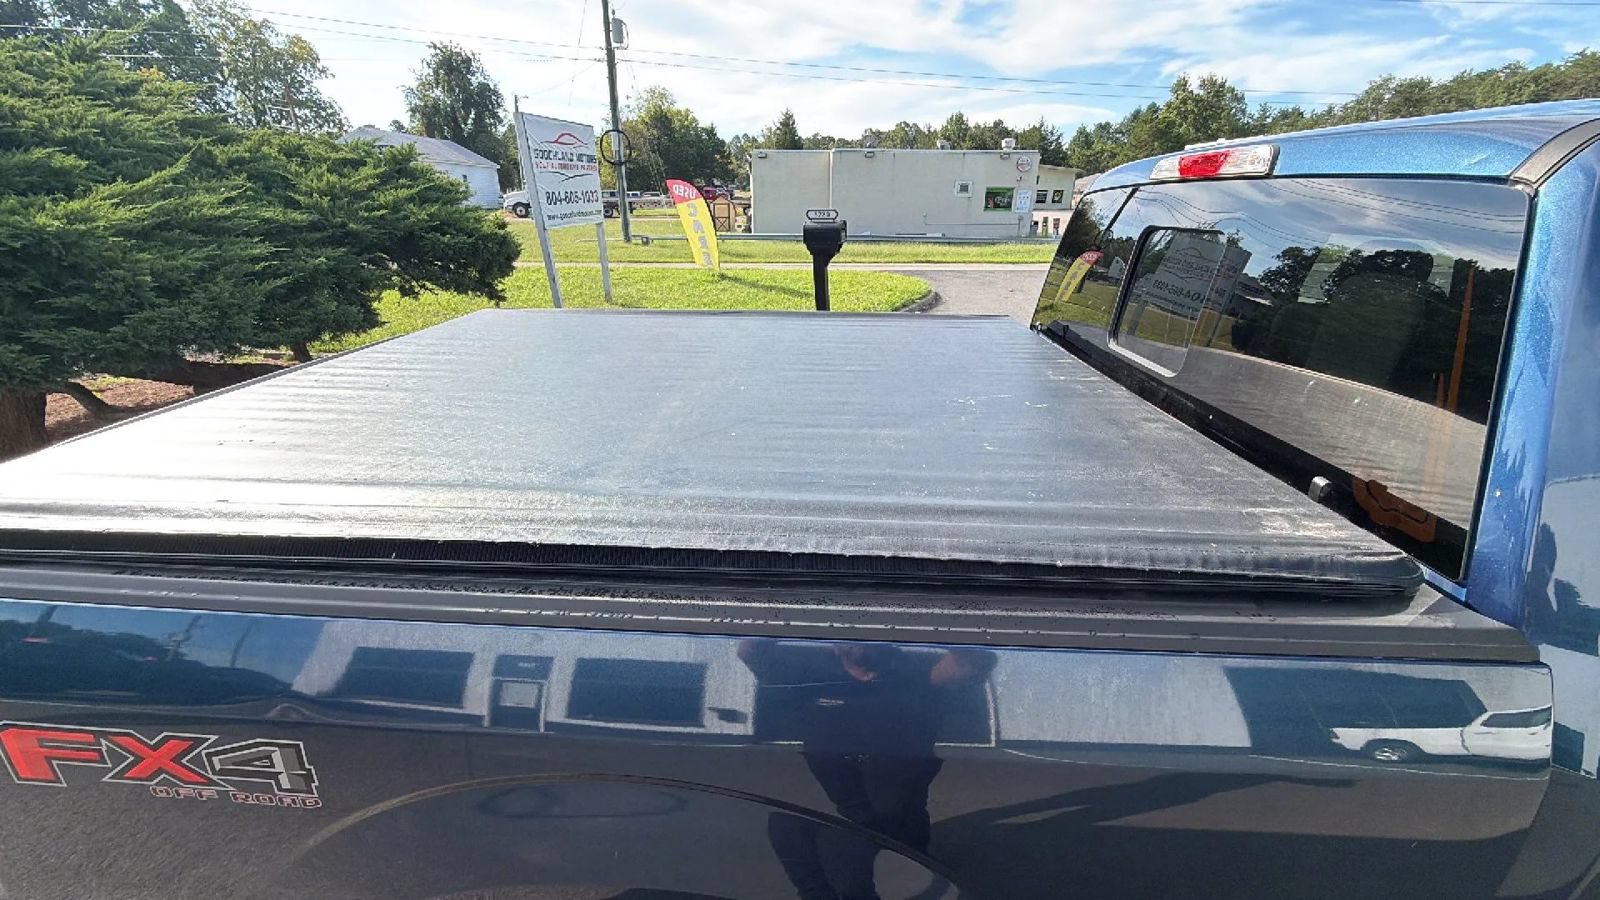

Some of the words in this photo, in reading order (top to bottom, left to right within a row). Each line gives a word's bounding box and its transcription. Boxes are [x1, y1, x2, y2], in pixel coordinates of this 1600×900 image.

[0, 720, 319, 797] FX4
[150, 785, 220, 800] OFF
[230, 792, 323, 808] ROAD
